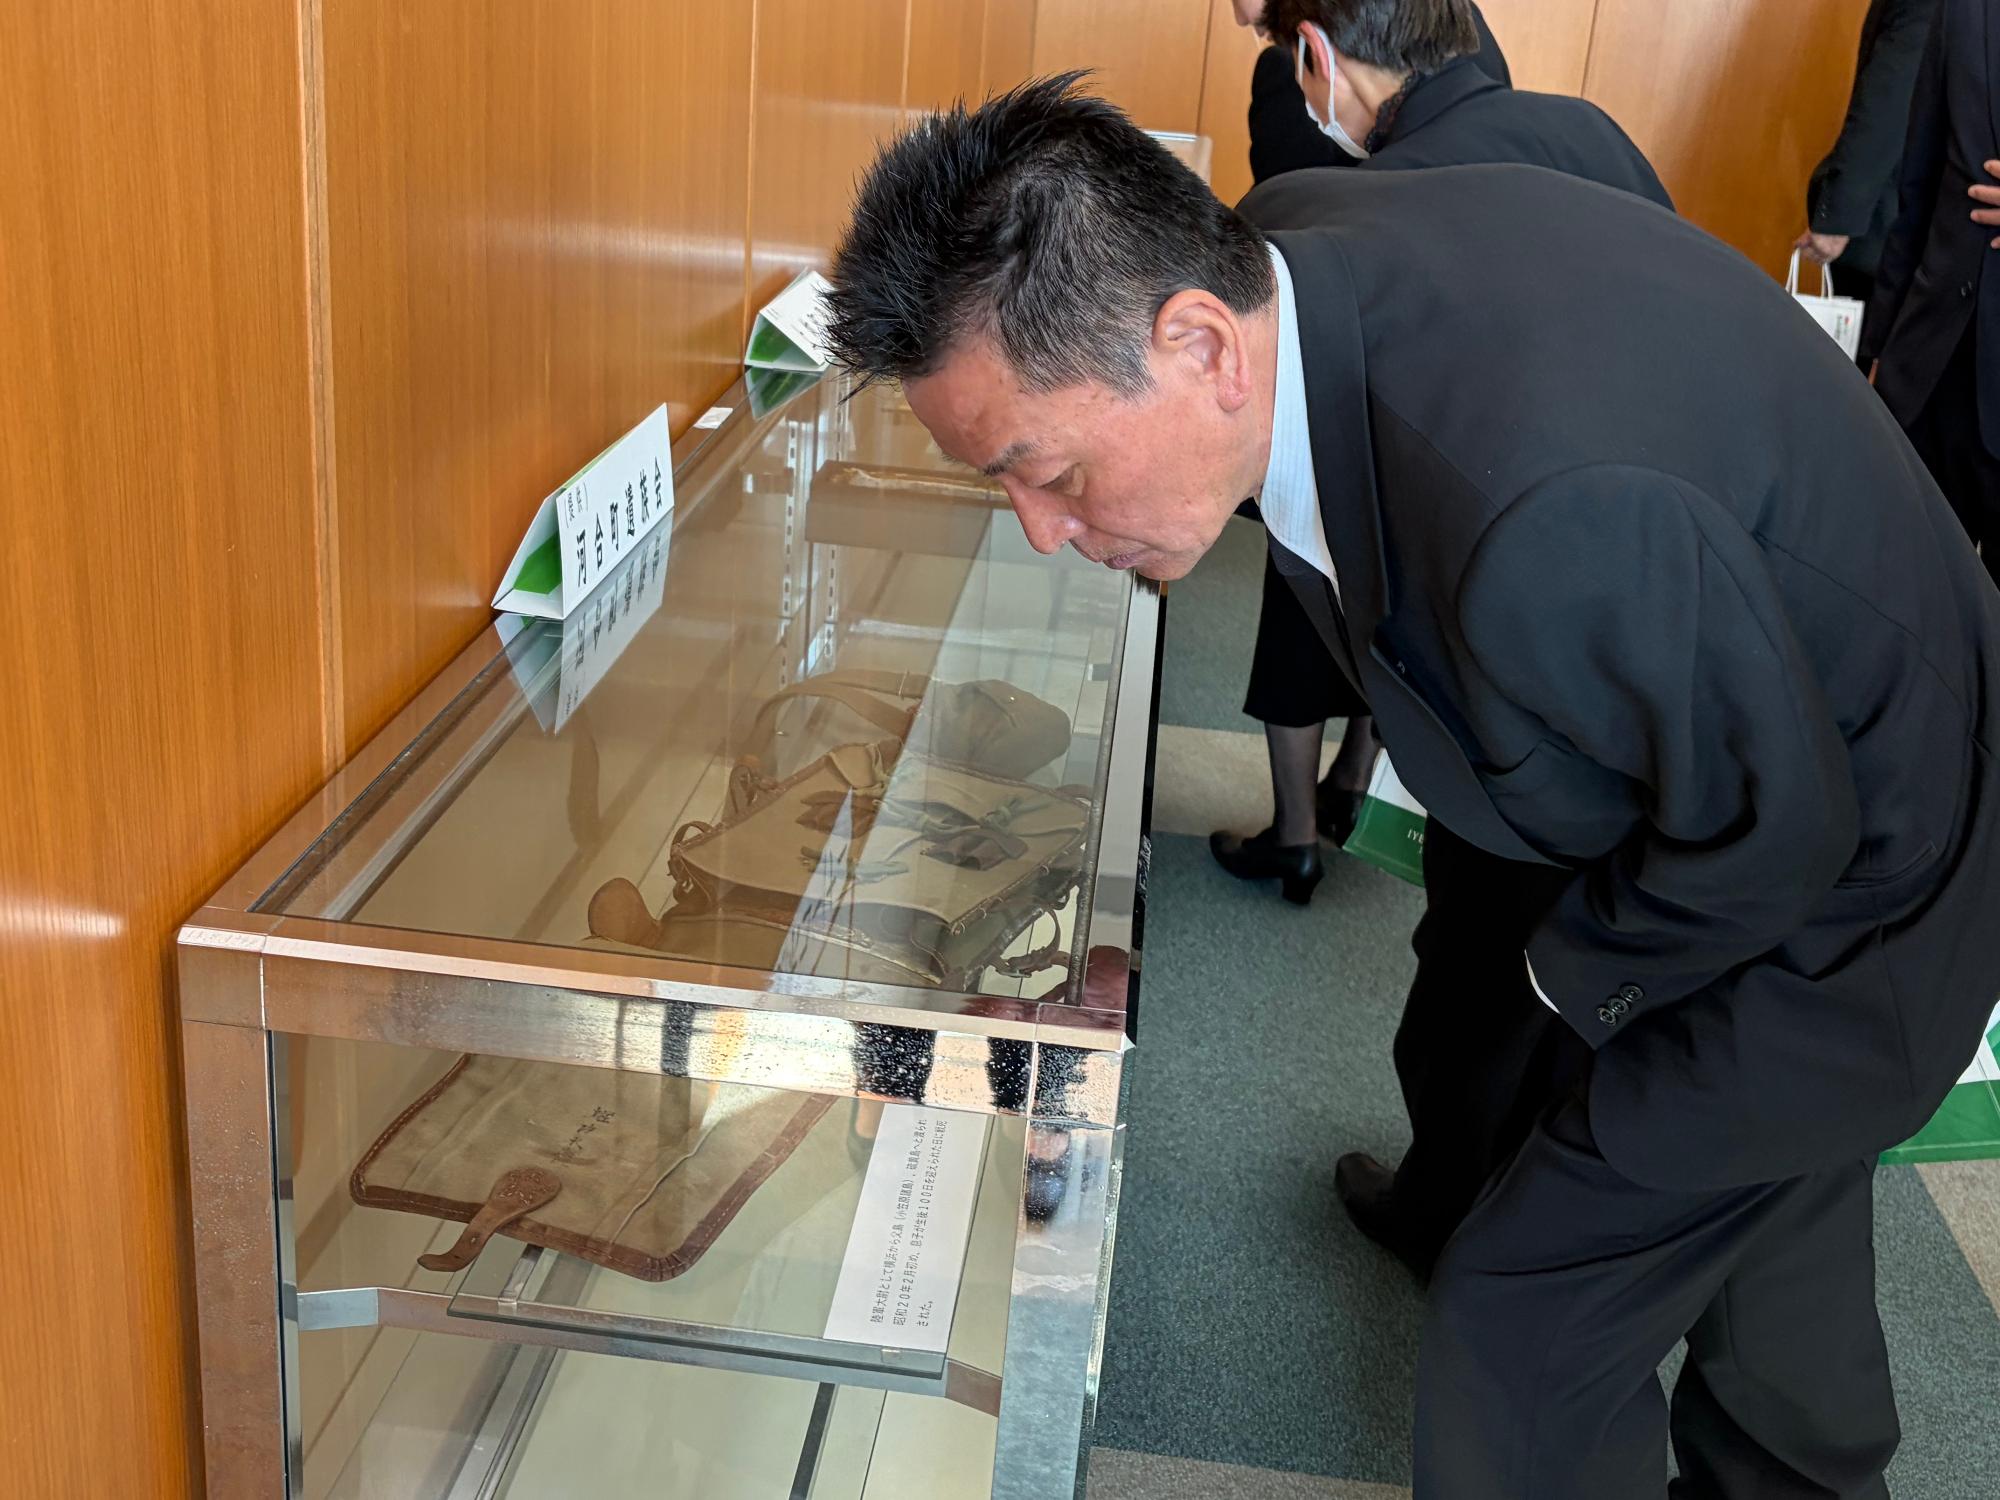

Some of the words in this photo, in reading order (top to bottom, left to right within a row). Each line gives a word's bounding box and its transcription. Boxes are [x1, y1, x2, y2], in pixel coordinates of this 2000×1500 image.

[577, 455, 663, 588] 河合町遺族会
[916, 1300, 934, 1327] された。
